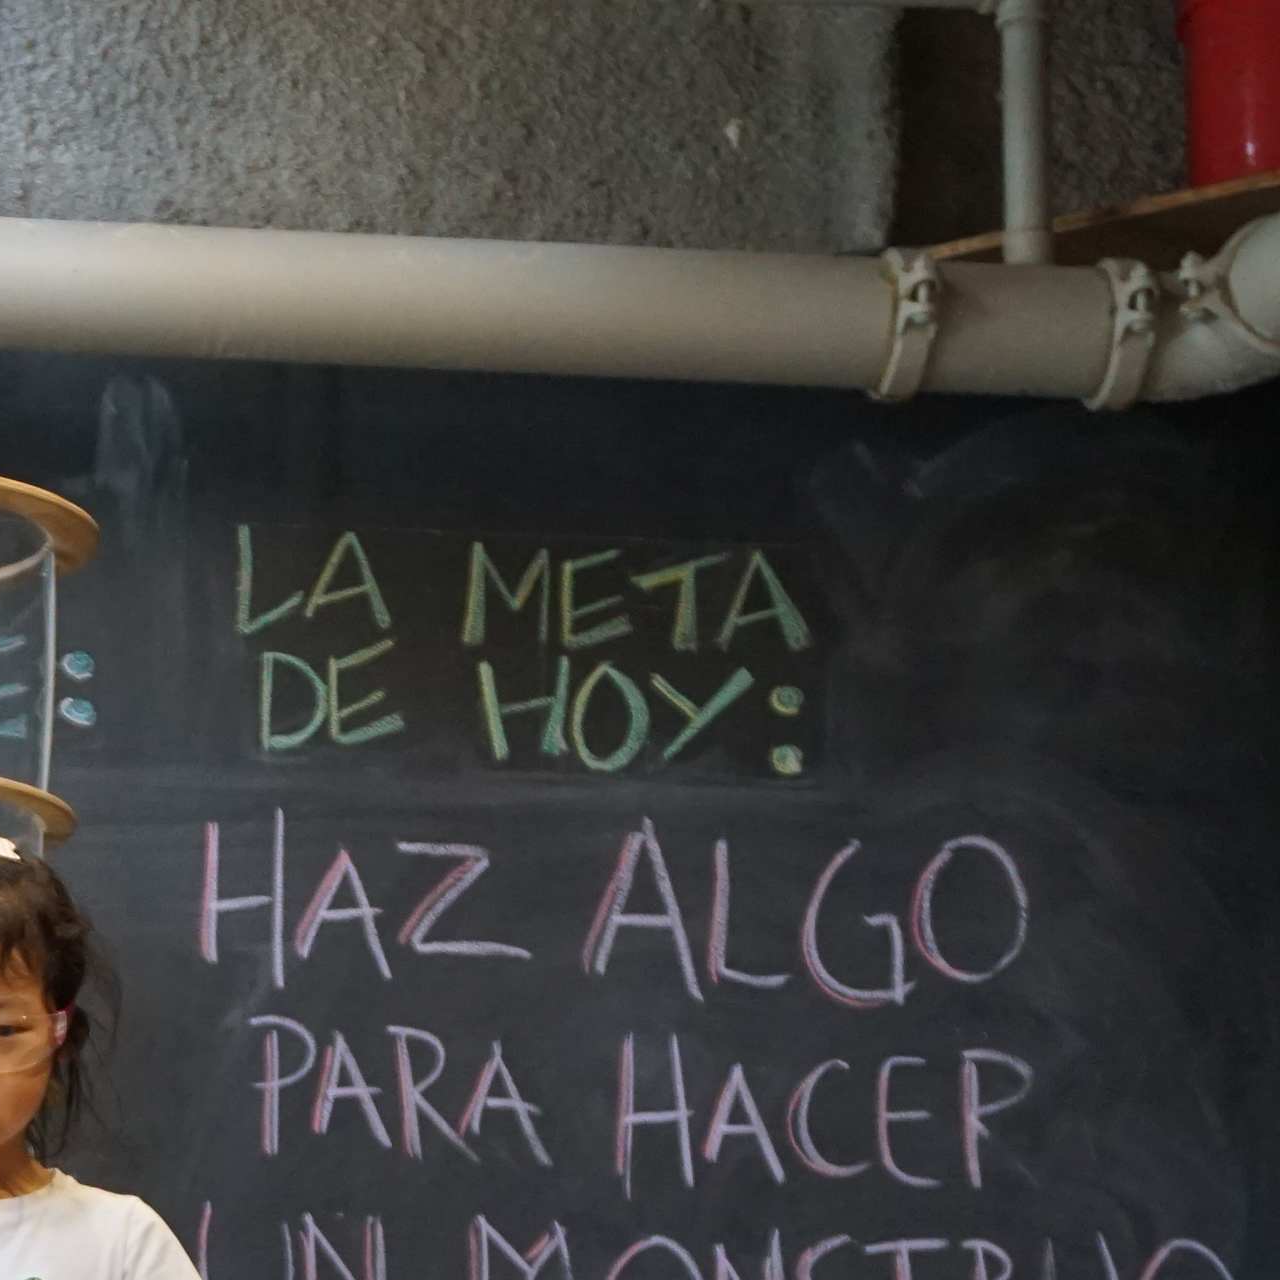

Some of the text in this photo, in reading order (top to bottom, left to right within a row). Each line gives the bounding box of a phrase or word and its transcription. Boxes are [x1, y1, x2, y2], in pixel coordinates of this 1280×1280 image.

[236, 524, 810, 652] LA META
[262, 640, 804, 775] DE HOY:
[200, 807, 1028, 1008] HAZ ALGO
[250, 1014, 552, 1167] PARA
